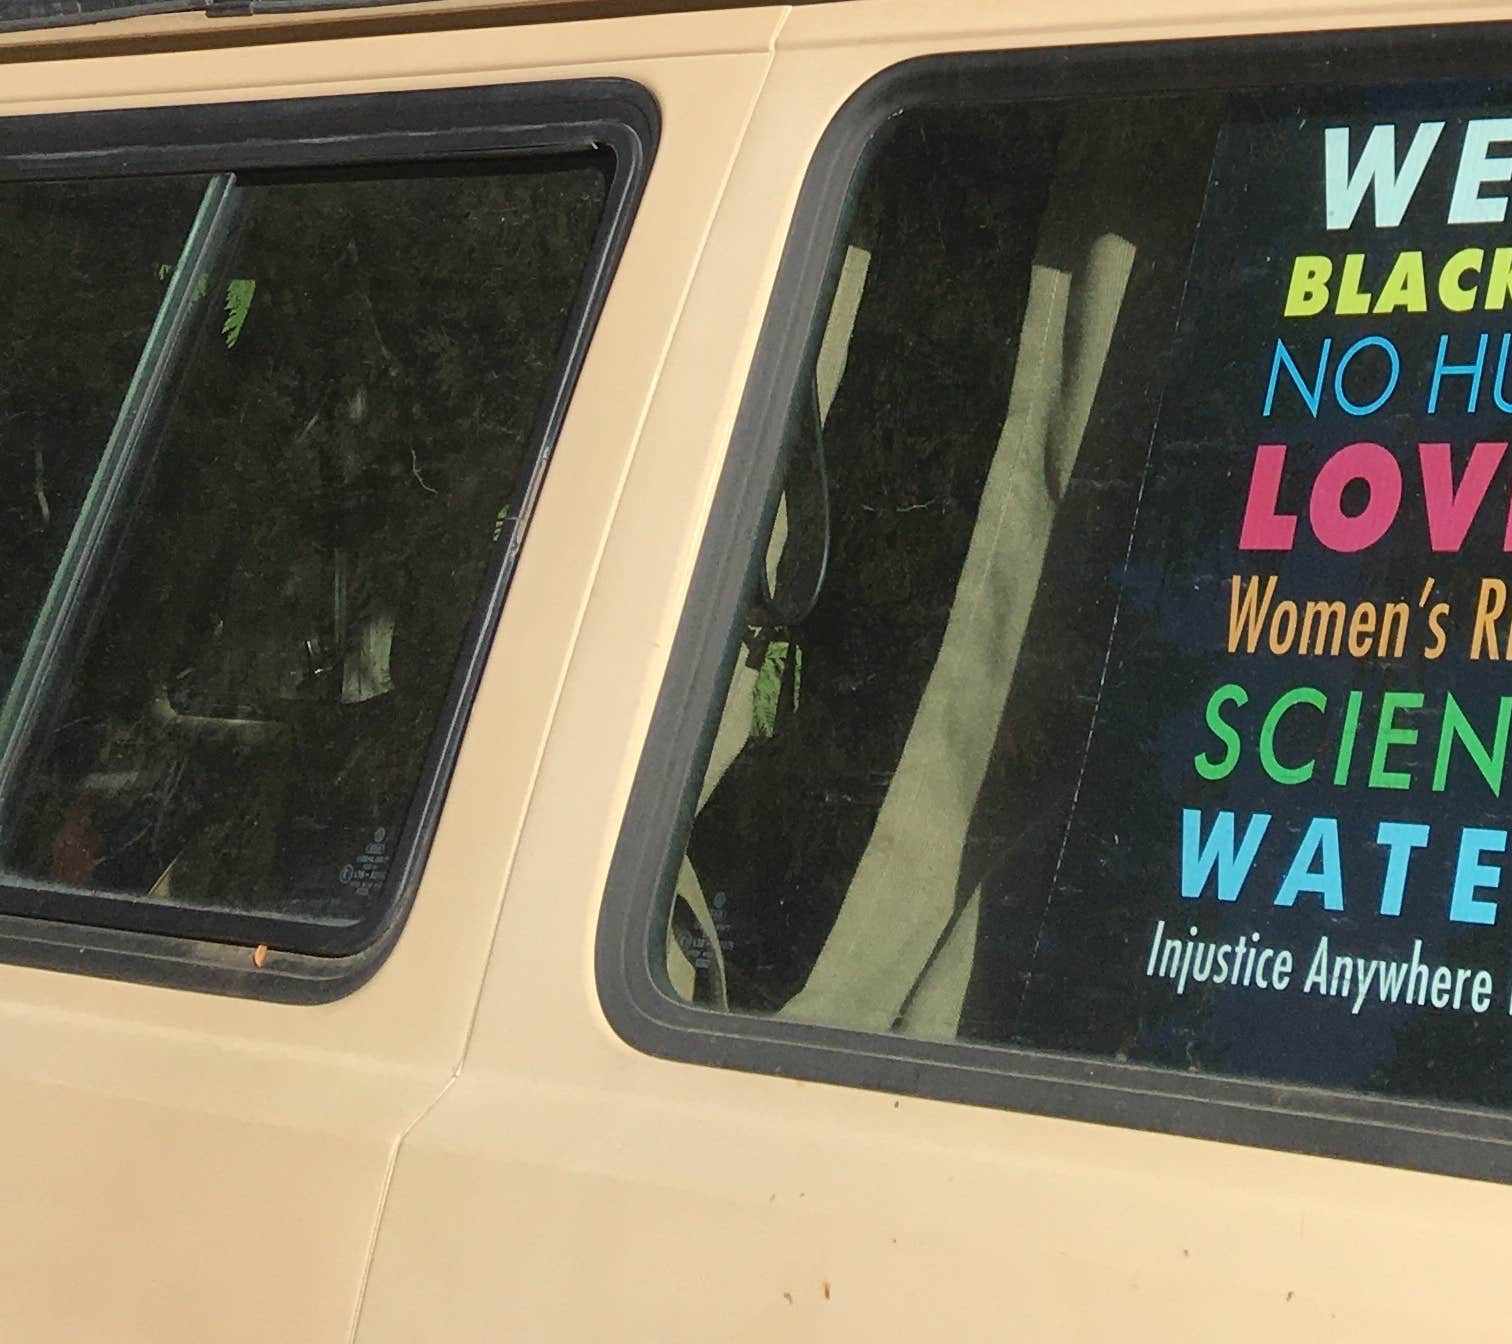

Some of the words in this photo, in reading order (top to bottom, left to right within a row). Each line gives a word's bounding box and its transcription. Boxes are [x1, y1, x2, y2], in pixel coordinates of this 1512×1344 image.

[1263, 336, 1399, 418] NO
[1228, 574, 1449, 661] Women's
[1147, 920, 1293, 994] Injustice
[1304, 935, 1492, 1015] Anywhere
